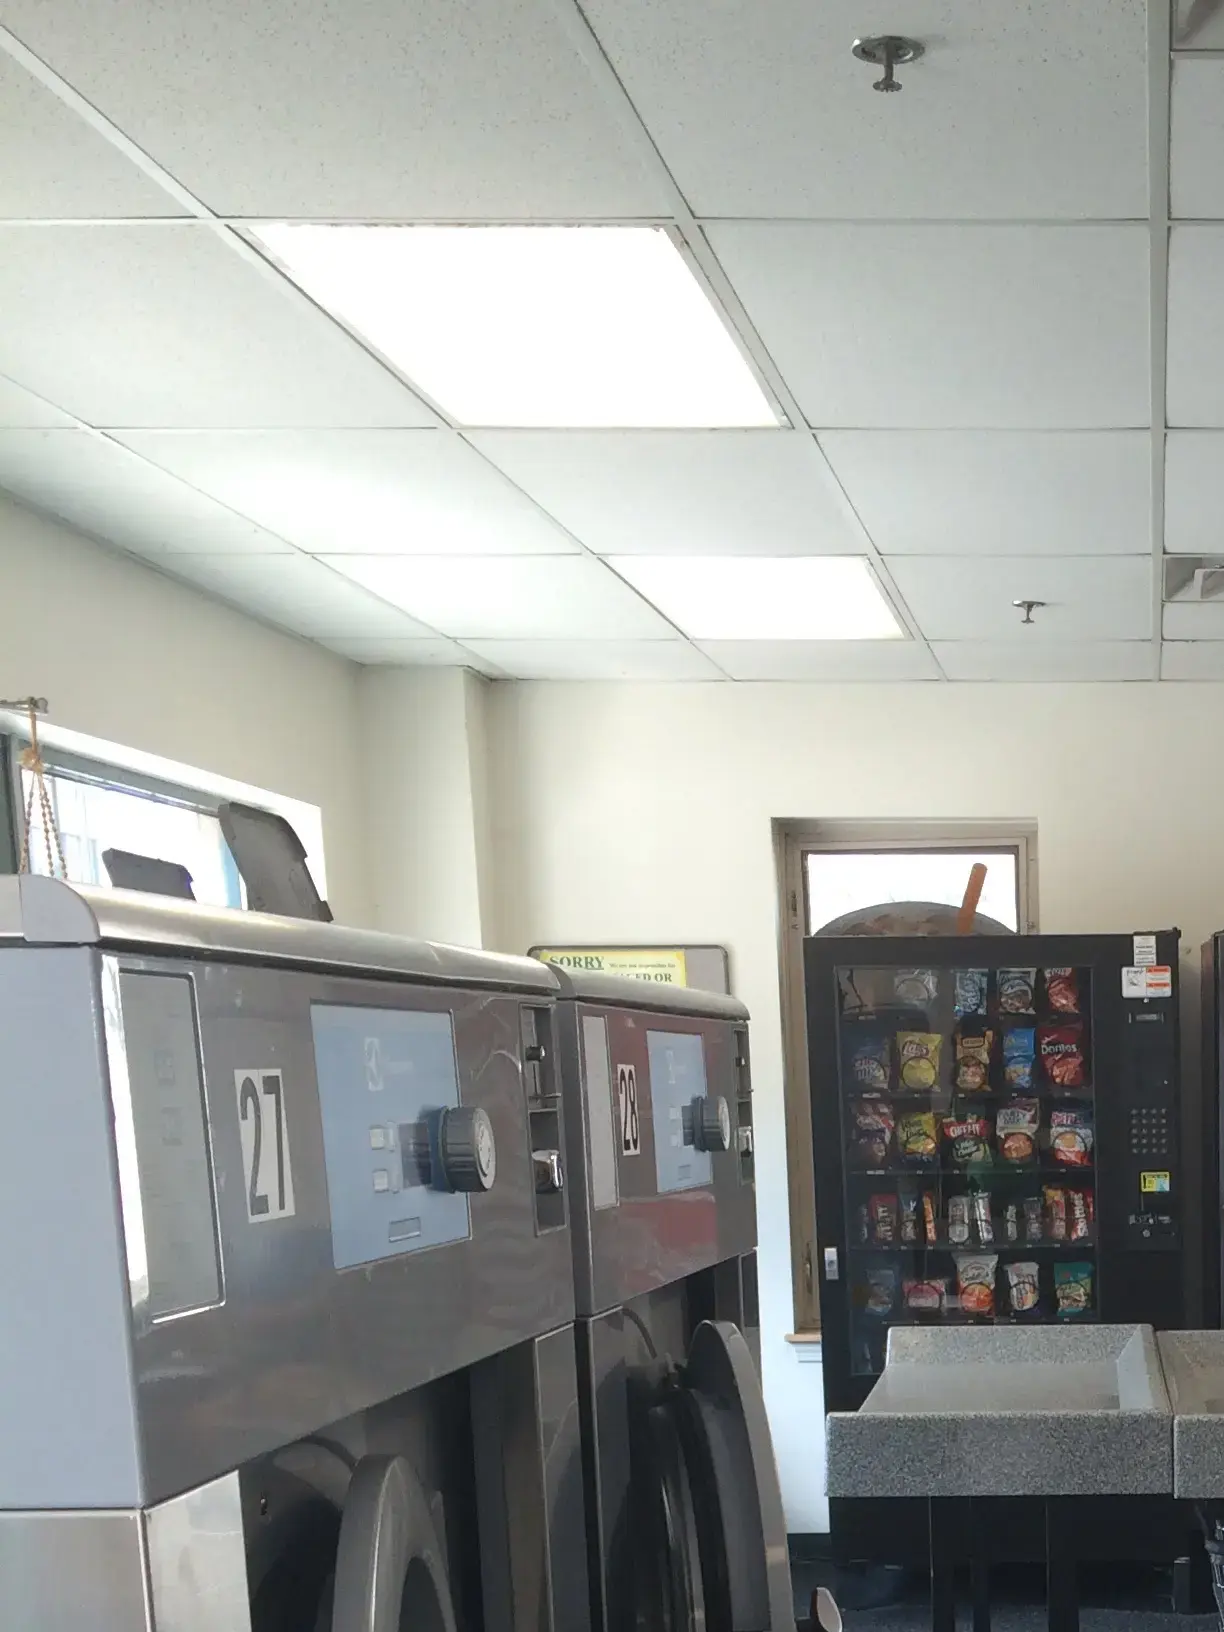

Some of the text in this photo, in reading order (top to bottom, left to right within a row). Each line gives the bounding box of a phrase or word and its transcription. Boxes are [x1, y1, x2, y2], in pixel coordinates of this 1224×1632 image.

[549, 956, 605, 969] SORRY
[1041, 1043, 1078, 1055] Doritos
[620, 1068, 639, 1151] 28
[240, 1075, 286, 1216] 27
